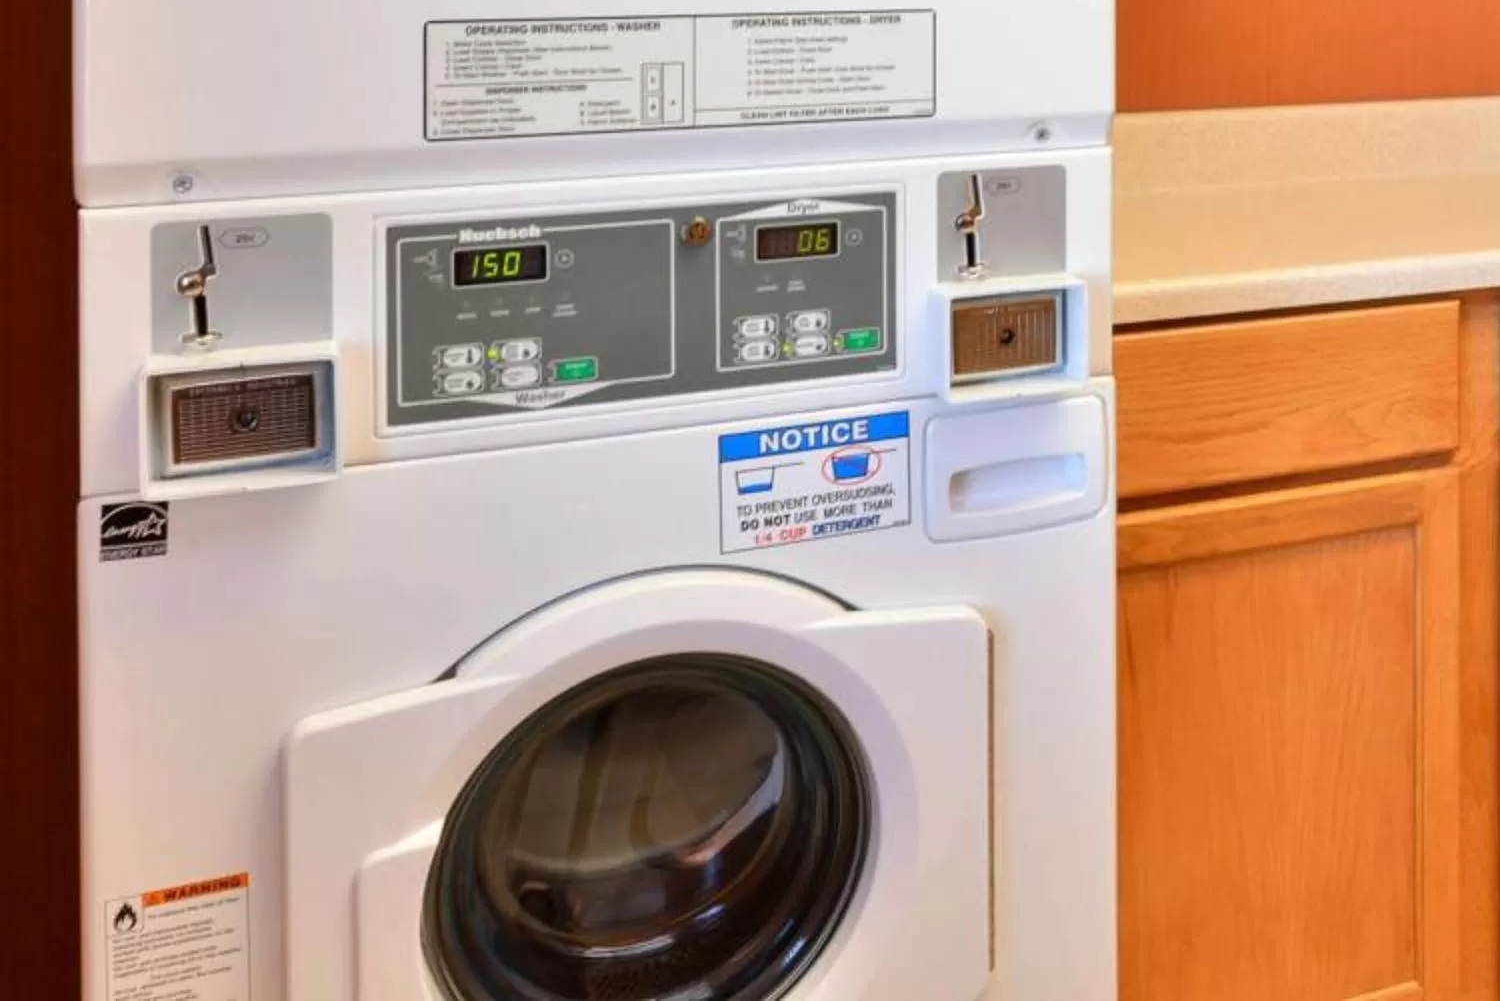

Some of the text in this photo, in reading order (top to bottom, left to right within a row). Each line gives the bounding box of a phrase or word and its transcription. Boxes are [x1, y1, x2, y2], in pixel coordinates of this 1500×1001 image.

[465, 22, 661, 36] OPERATING INSTRUCTIONS WASHER
[731, 14, 901, 29] OPERATING INSTRUCTIONS DRYER
[787, 202, 820, 215] Dryer
[459, 224, 542, 244] Huebsch
[797, 229, 830, 252] 06
[471, 251, 521, 278] 150
[515, 389, 566, 404] Washer
[759, 420, 869, 454] NOTICE
[737, 504, 753, 517] TO
[755, 495, 809, 515] PREVENT
[741, 498, 893, 533] DO NOT USE MORE THAN
[779, 526, 806, 542] CUP
[812, 514, 881, 536] DETERGENT
[163, 877, 242, 902] WARNING
